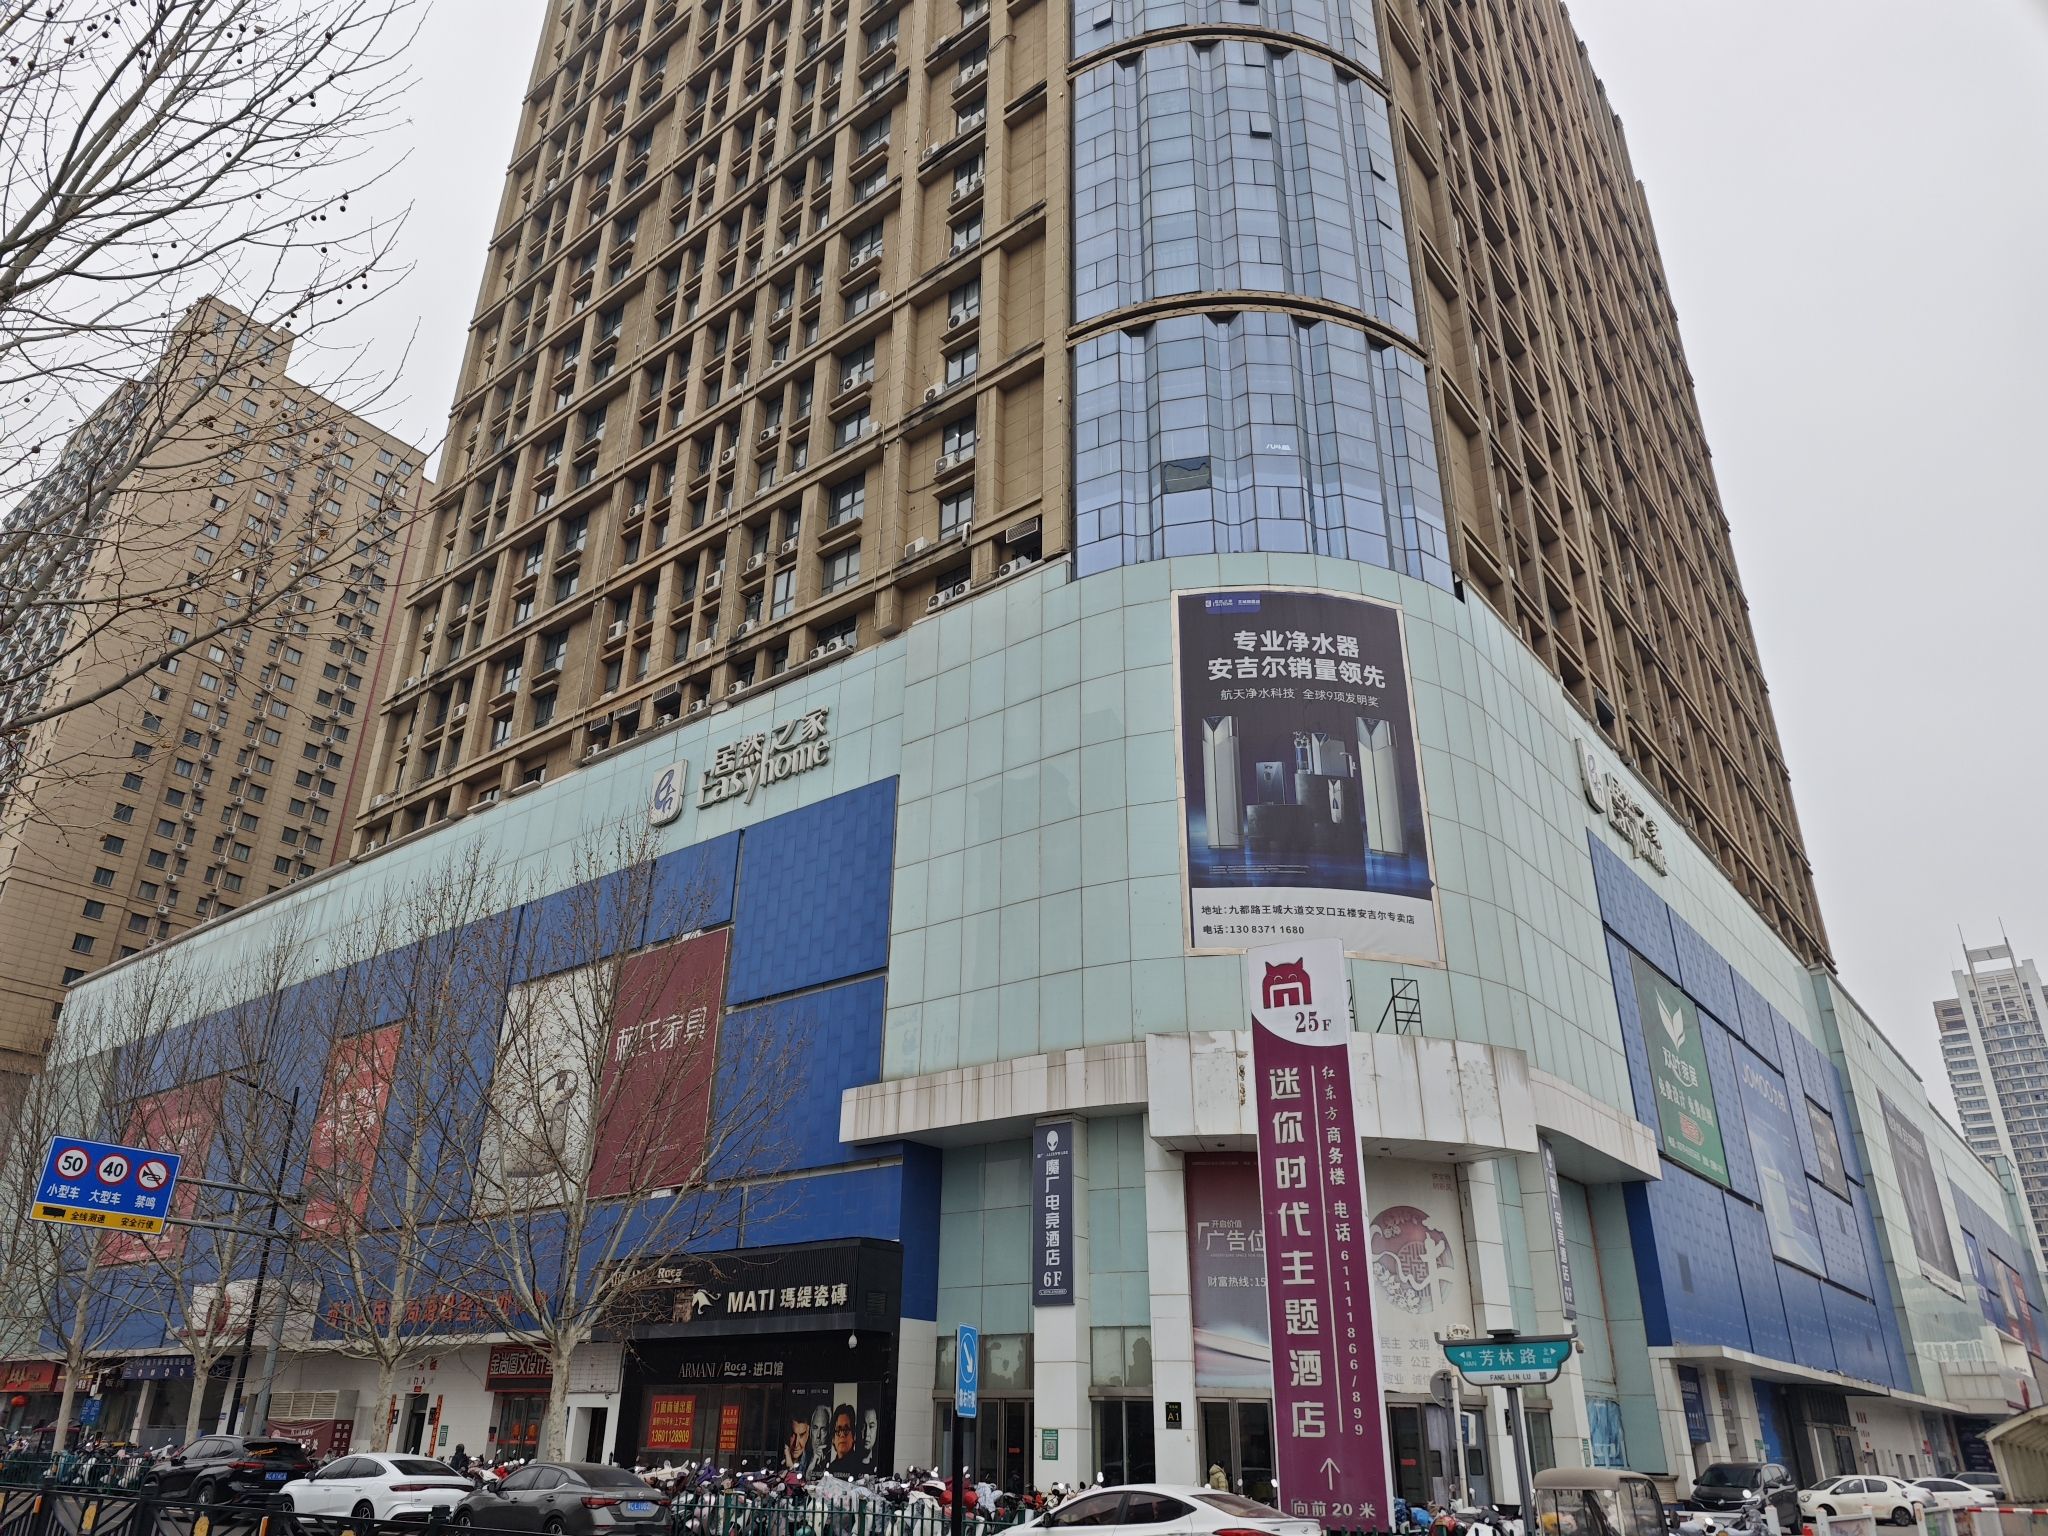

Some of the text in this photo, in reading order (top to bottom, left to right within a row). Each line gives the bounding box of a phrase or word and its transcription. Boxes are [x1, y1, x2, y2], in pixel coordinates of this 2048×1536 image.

[1233, 630, 1360, 658] 专业净水器
[1208, 656, 1386, 689] 安吉尔销量领先
[1220, 688, 1380, 707] 航天净水科技 全球9项发明奖
[710, 705, 829, 777] 居然之家
[697, 738, 830, 809] Easyhome
[1201, 905, 1415, 925] 地址:九都路王城大道交叉口五楼安吉尔专卖店
[1321, 1066, 1346, 1186] 红东方商务楼
[61, 1155, 124, 1178] 50 40
[46, 1183, 157, 1210] 小型车 大型车 禁鸣
[70, 1211, 106, 1224] 全线测速
[1045, 1158, 1061, 1267] 魔厂电竞酒店
[1212, 1220, 1242, 1228] 开启价值
[1206, 1230, 1265, 1252] 广告位
[1269, 1066, 1326, 1438] 迷你时代主题酒店
[1043, 1271, 1063, 1288] 6F
[727, 1289, 775, 1313] MATI
[1408, 1337, 1430, 1351] 文明
[1410, 1356, 1432, 1369] 公正
[1478, 1347, 1537, 1366] 芳林路
[679, 1362, 716, 1378] ARMANI
[724, 1361, 747, 1374] Roca
[753, 1361, 784, 1377] 进口馆
[653, 1400, 693, 1414] 门面商铺出租
[1167, 1412, 1180, 1422] A1
[1293, 1500, 1376, 1519] 向前 20 米
